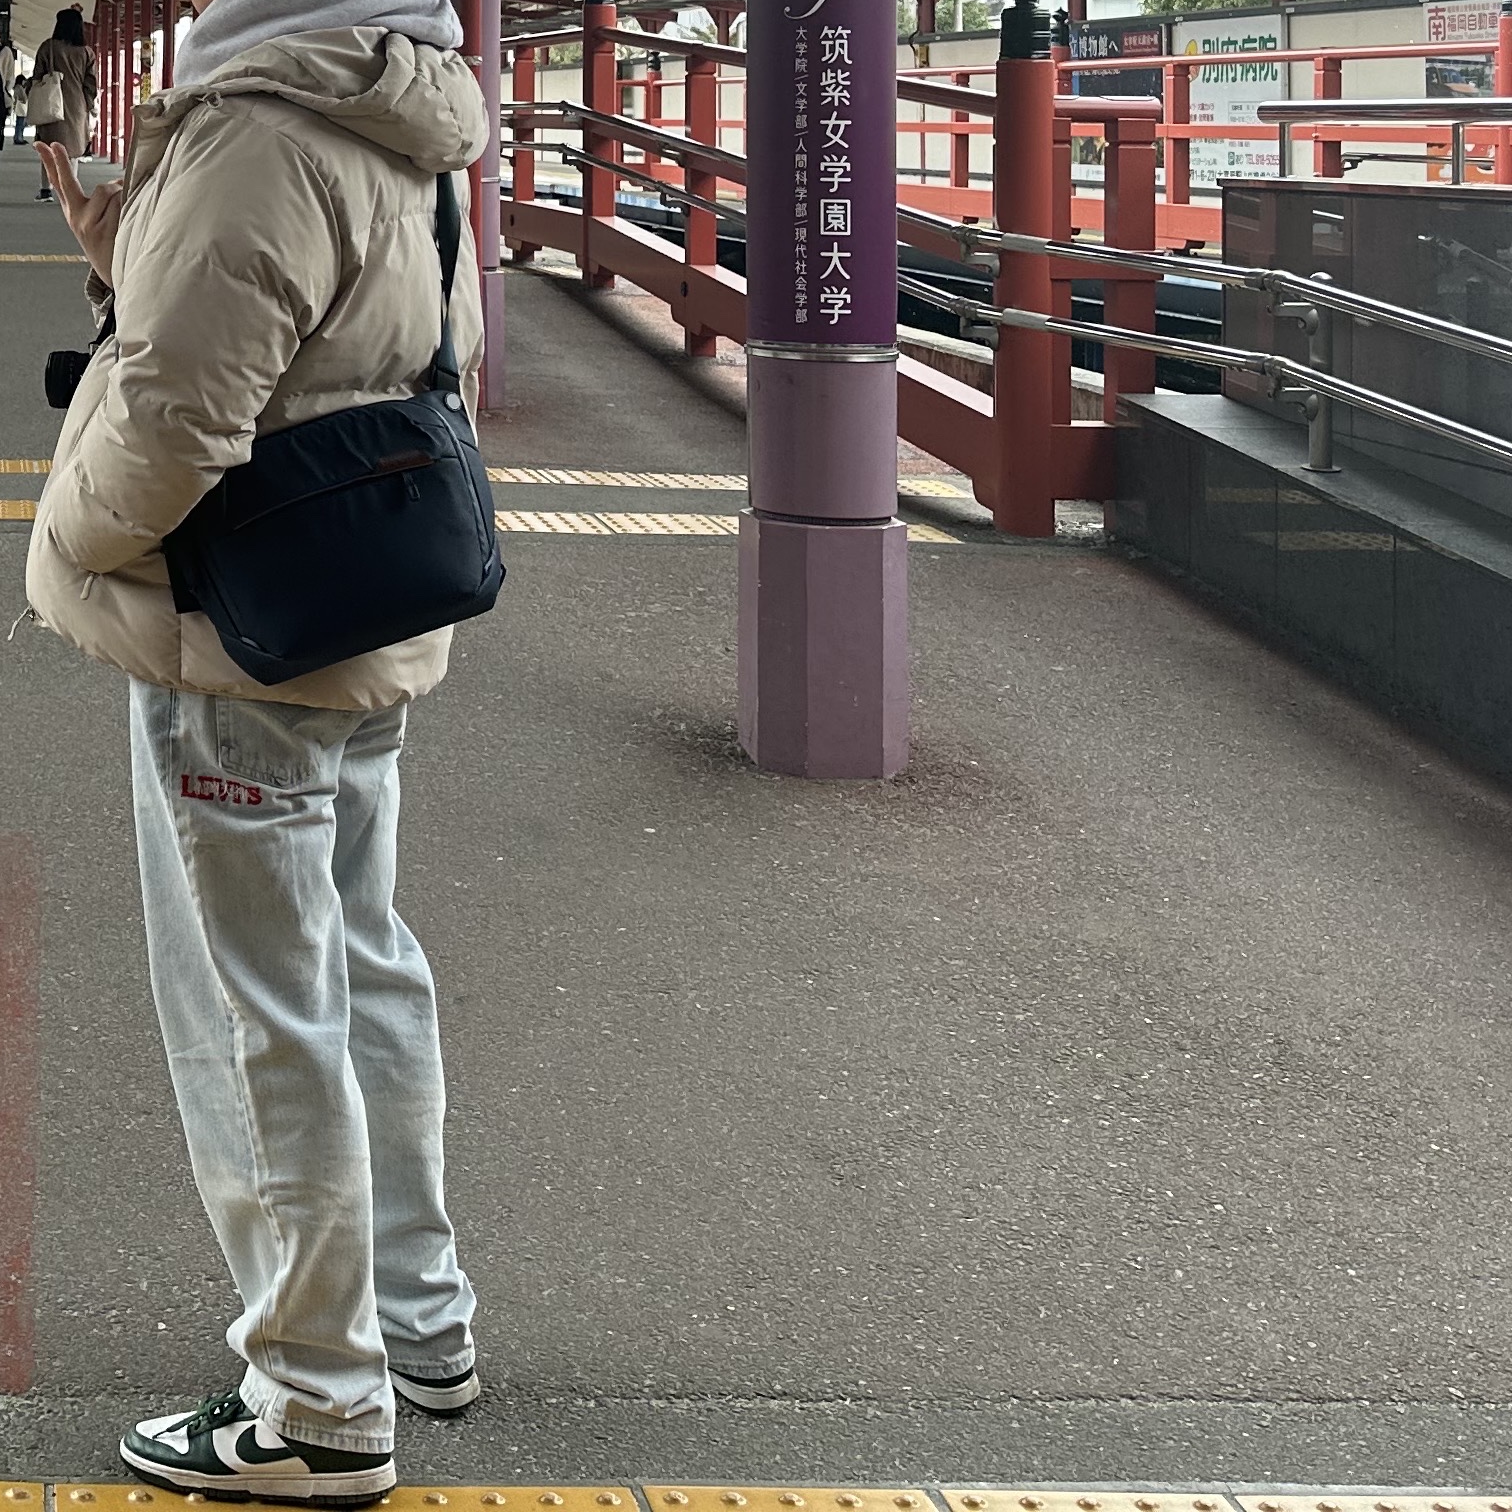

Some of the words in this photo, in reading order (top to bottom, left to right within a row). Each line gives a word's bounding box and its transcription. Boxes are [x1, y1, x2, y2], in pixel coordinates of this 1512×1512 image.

[819, 25, 853, 325] 筑紫女学園大学
